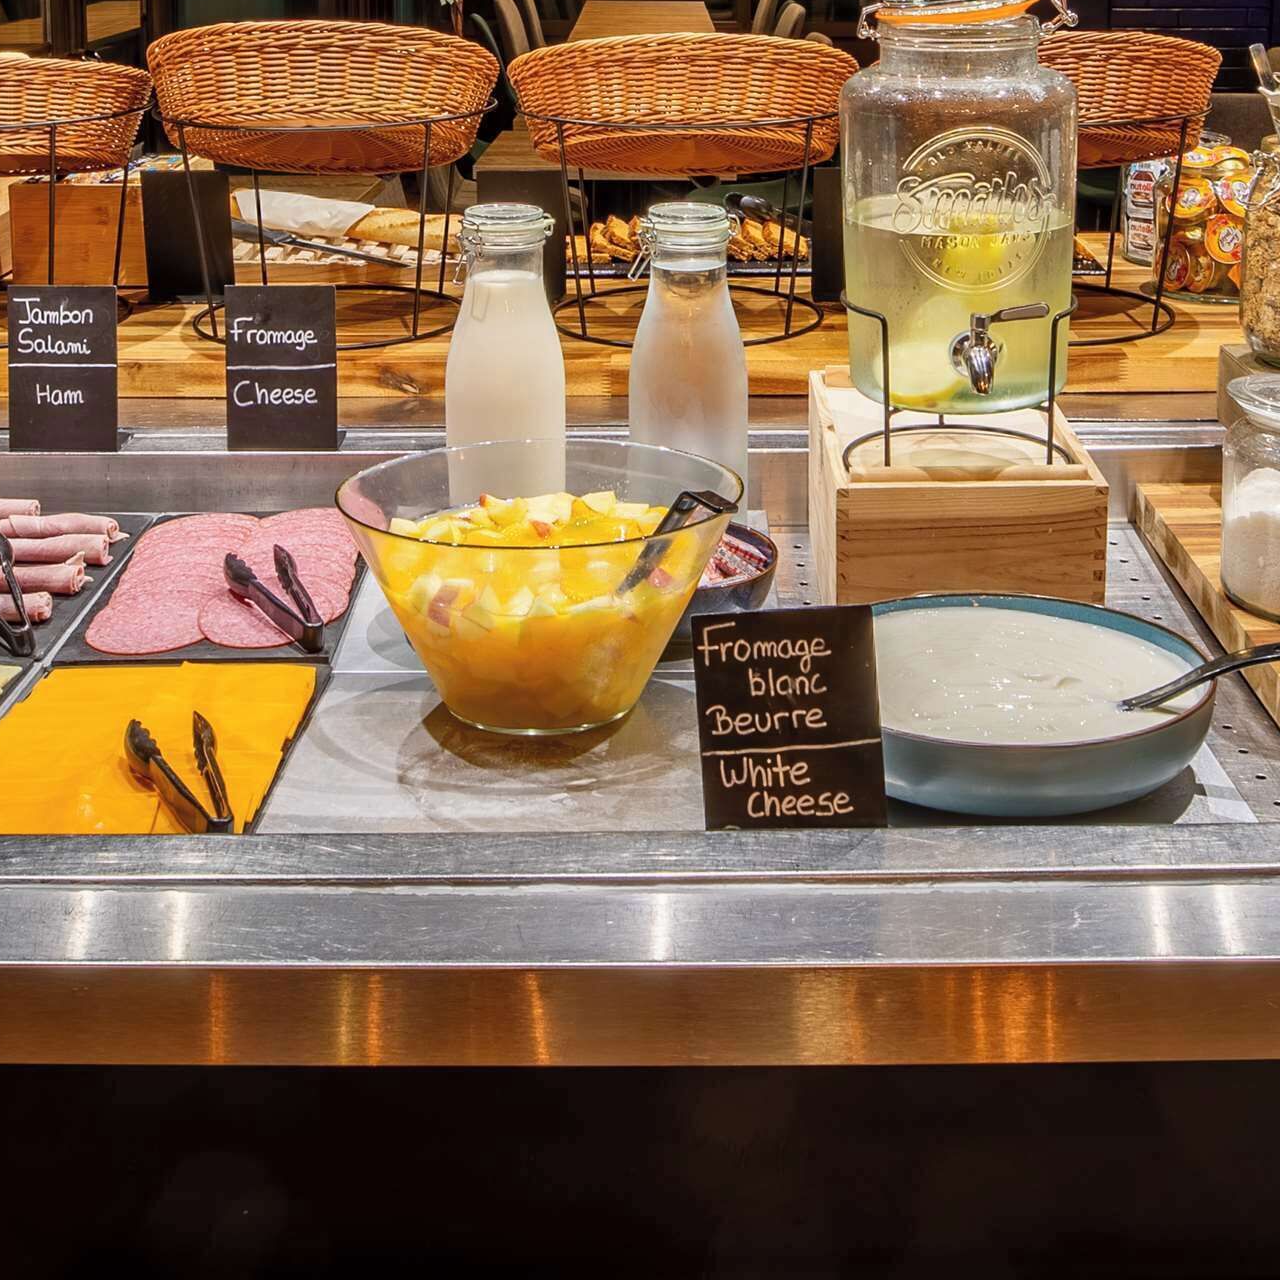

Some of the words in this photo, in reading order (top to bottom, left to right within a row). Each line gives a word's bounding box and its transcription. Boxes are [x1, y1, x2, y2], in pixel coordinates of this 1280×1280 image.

[13, 297, 94, 326] Jambon
[17, 327, 92, 355] Salami
[229, 316, 318, 351] Fromage
[36, 383, 84, 405] Ham
[233, 380, 318, 407] Cheese
[697, 621, 832, 673] Fromage
[748, 667, 827, 696] blanc
[705, 705, 827, 735] Beurre
[720, 753, 811, 788] White
